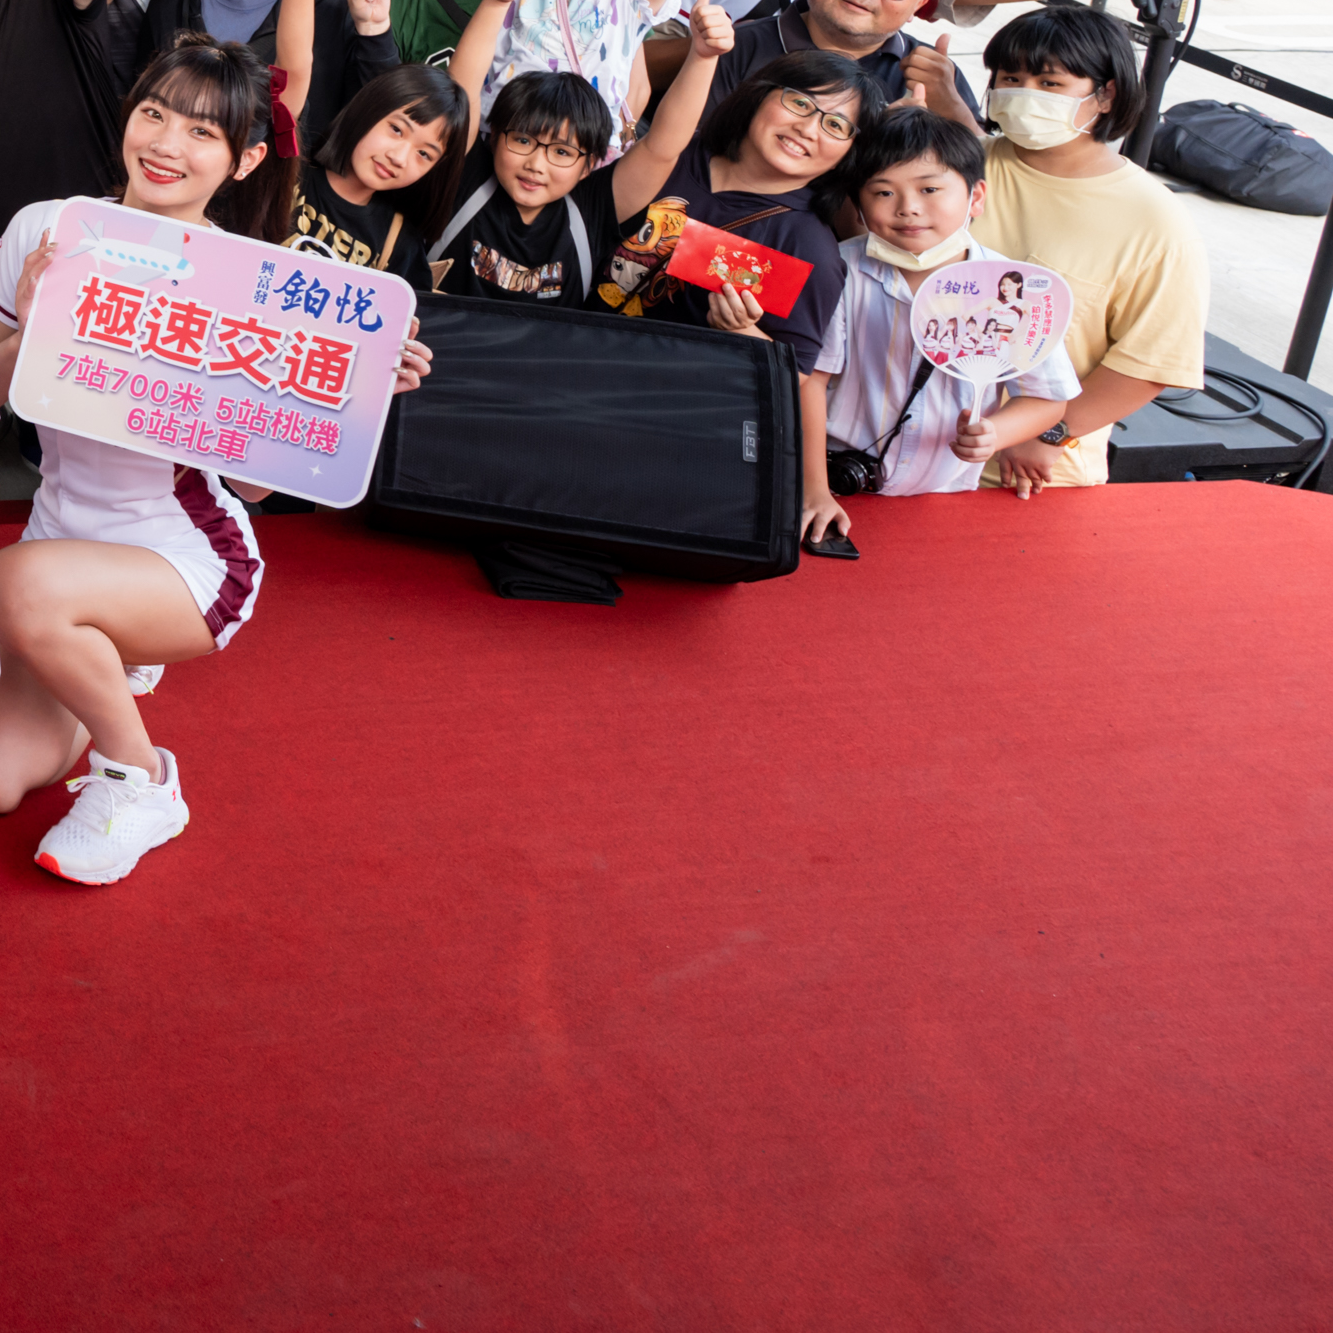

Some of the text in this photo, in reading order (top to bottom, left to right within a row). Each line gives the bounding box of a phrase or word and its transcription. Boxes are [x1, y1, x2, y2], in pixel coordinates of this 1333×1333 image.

[254, 260, 276, 306] 興富發
[75, 277, 356, 406] 極速交通
[55, 352, 342, 454] 7站700米 5站桃機
[126, 407, 251, 462] 6站北車
